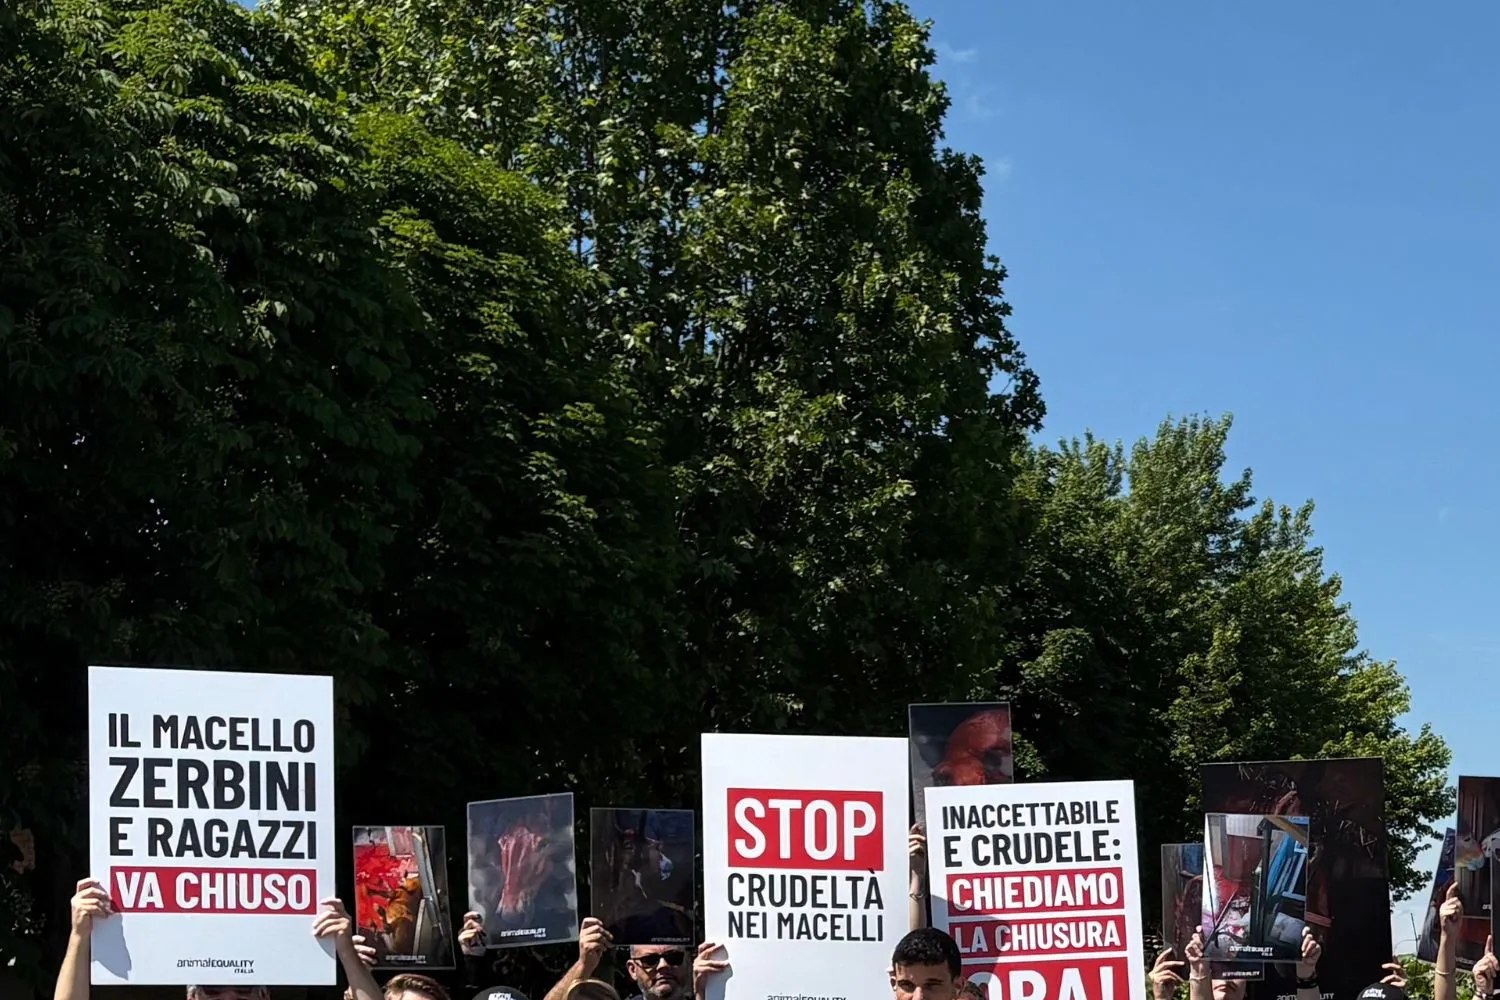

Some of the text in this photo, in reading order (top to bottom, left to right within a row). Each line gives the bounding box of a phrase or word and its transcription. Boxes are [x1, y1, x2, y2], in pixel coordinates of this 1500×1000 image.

[109, 713, 314, 753] IL MACELLO
[109, 757, 316, 811] ZERBINI
[735, 798, 876, 860] STOP
[943, 800, 1119, 830] INACCETTABILE
[110, 817, 316, 859] E RAGAZZI
[944, 831, 1121, 867] E CRUDELE:
[116, 872, 310, 910] VA CHIUSO
[728, 867, 883, 909] CRUDELTÀ
[952, 873, 1118, 911] CHIEDIAMO
[729, 911, 883, 941] NEI MACELLI
[954, 920, 1121, 954] LA CHIUSURA
